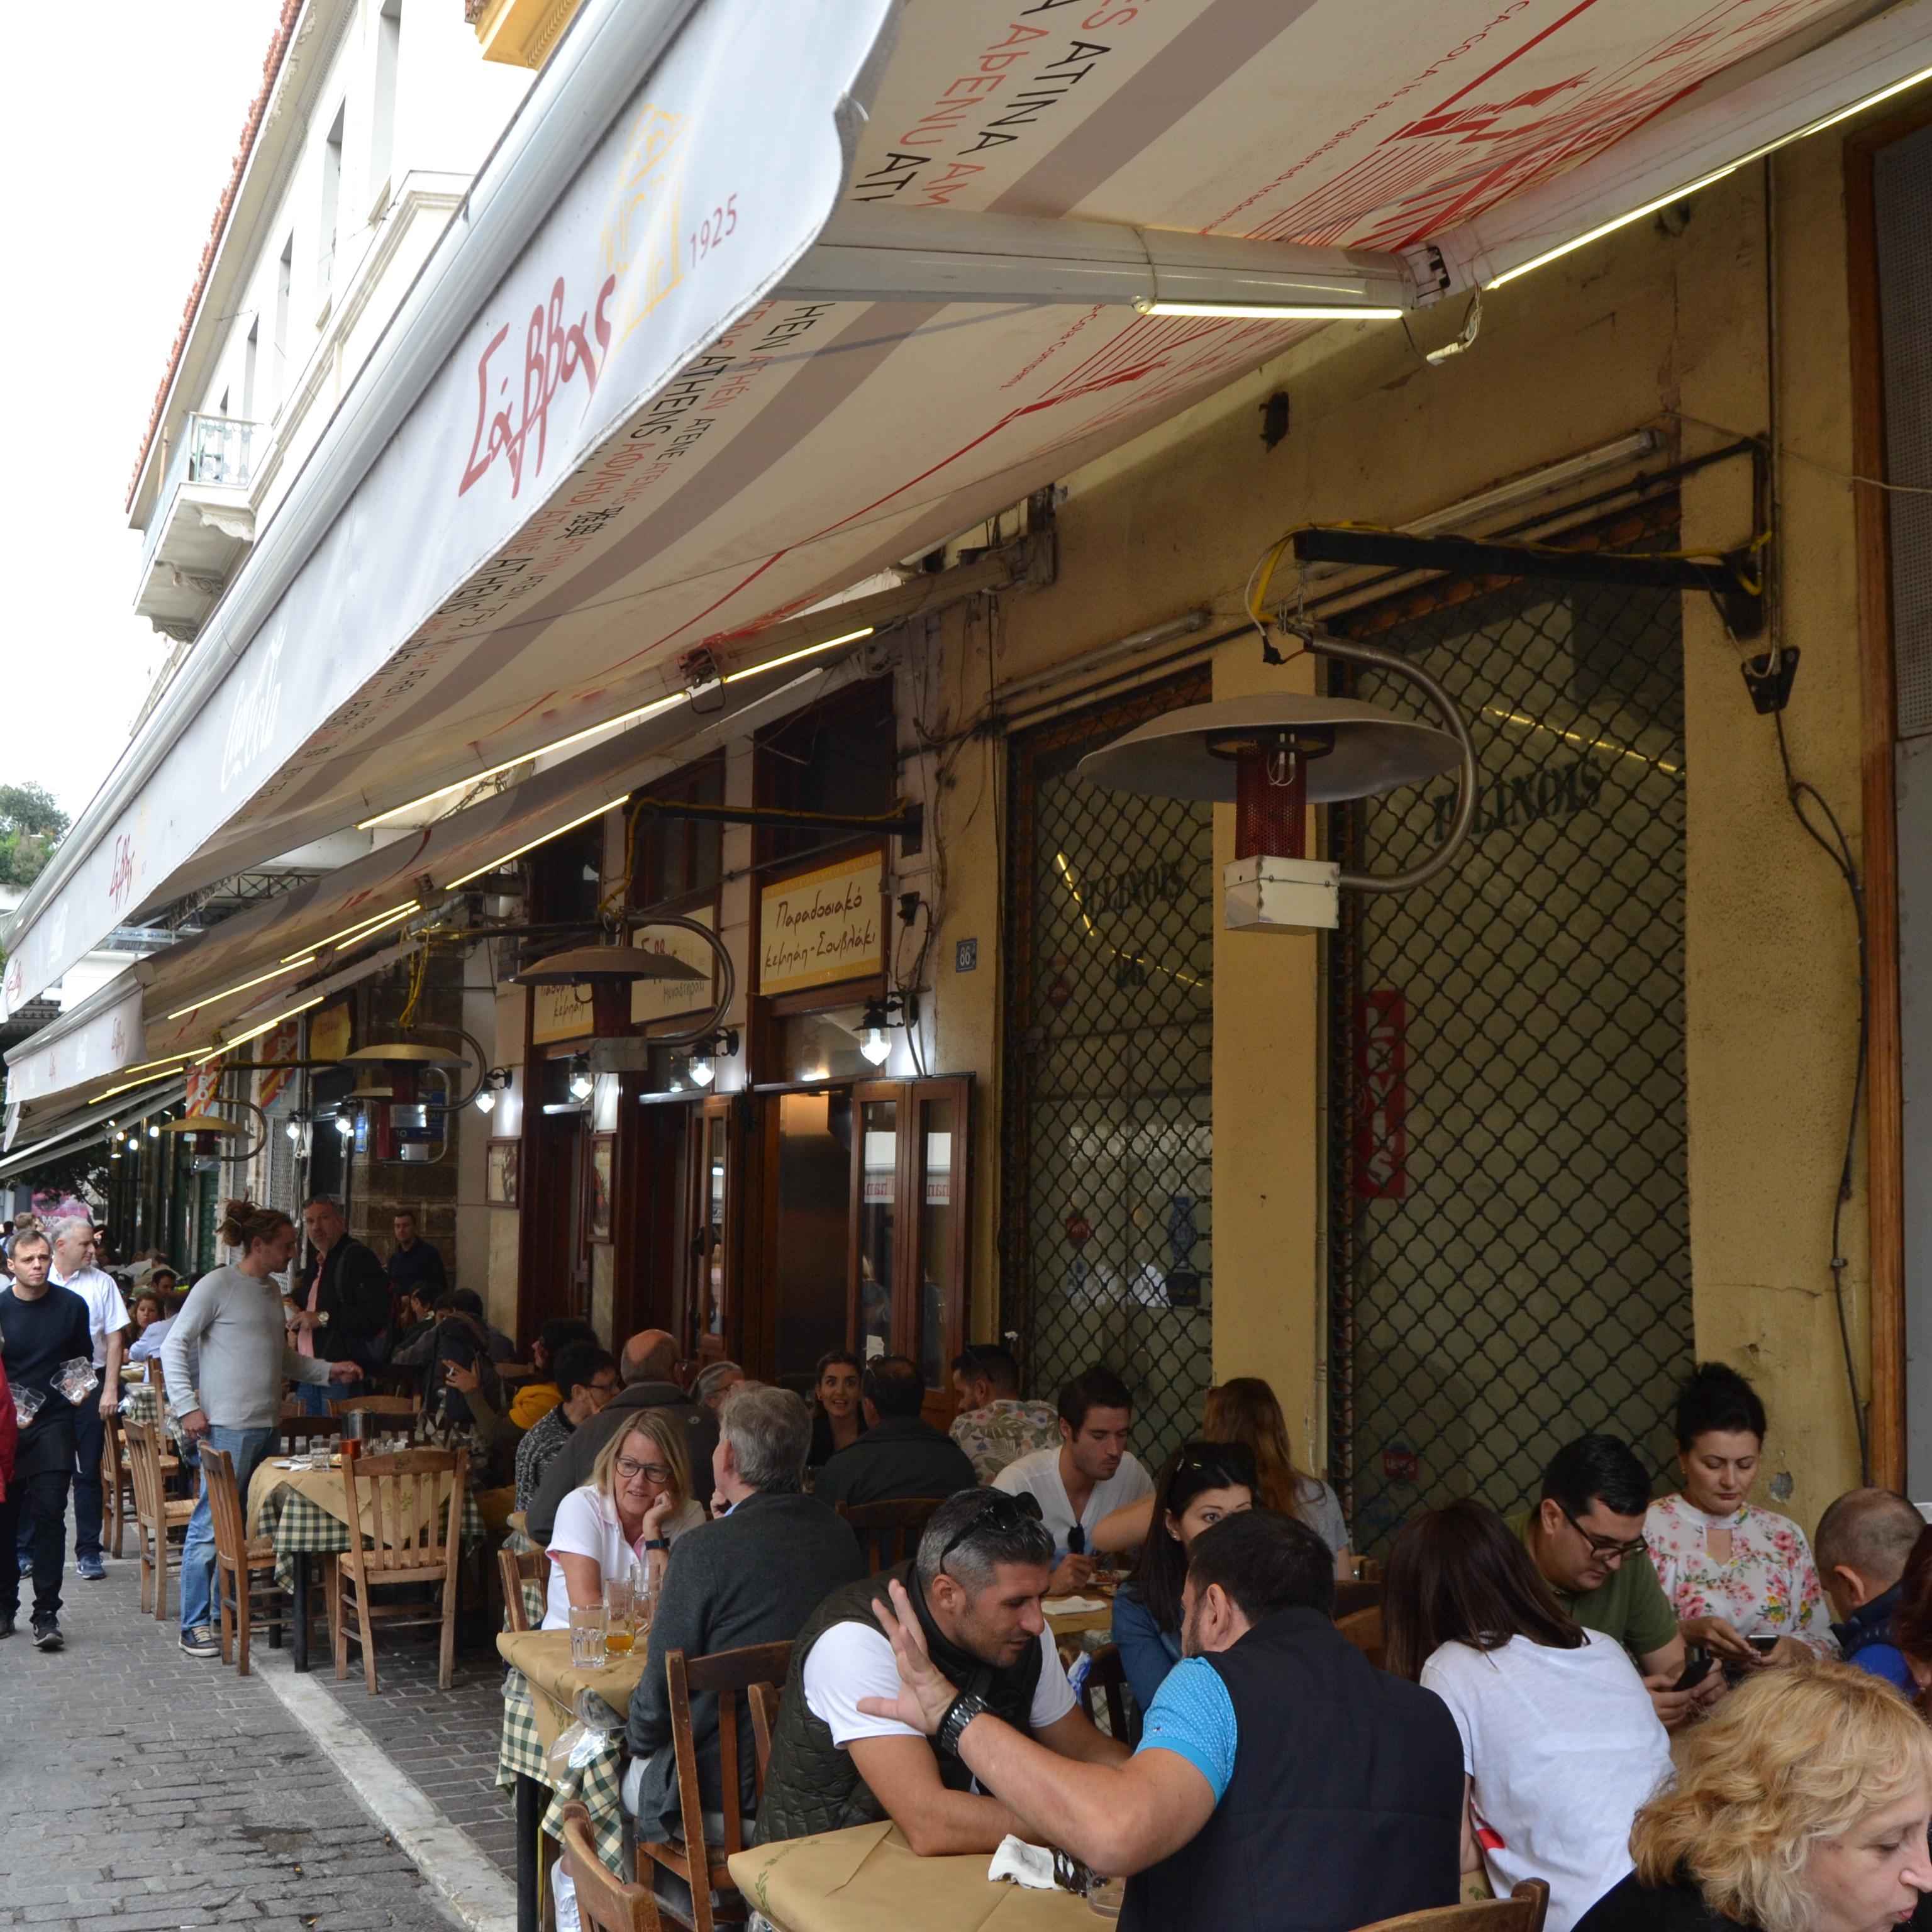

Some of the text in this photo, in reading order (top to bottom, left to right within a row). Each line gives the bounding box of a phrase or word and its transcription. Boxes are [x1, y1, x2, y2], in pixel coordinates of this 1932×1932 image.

[957, 40, 1111, 155] ATINA
[850, 152, 931, 201] ATI
[690, 192, 738, 269] 1925
[749, 303, 836, 352] HEN
[630, 356, 737, 439] ATHENS
[655, 418, 716, 460] ATENE
[565, 443, 656, 507] АФИНЫ
[611, 462, 673, 505] ATENAS
[438, 557, 534, 615] ATHENS
[776, 882, 863, 935] Παραδοσιακό
[960, 945, 970, 966] 86
